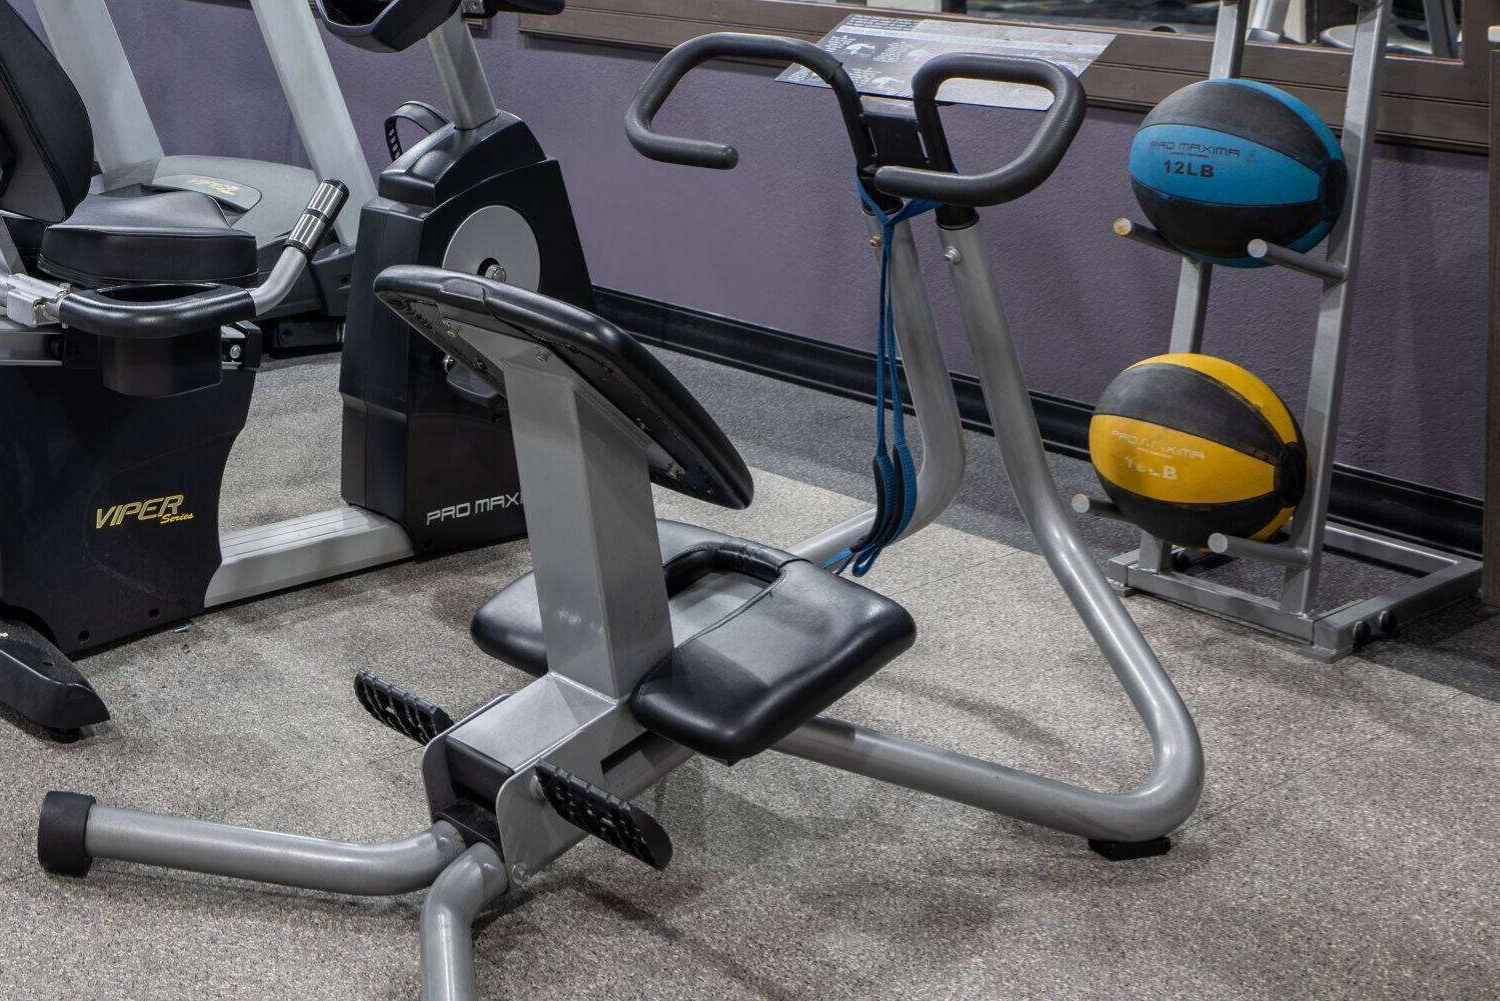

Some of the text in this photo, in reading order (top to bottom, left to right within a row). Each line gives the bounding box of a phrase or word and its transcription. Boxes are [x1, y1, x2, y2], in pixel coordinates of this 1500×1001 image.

[1149, 141, 1176, 150] PRO
[1179, 143, 1240, 158] MAXIMA
[1164, 160, 1214, 178] 12LB
[95, 494, 184, 529] VIPER
[160, 513, 194, 525] Series
[426, 502, 471, 526] PRO
